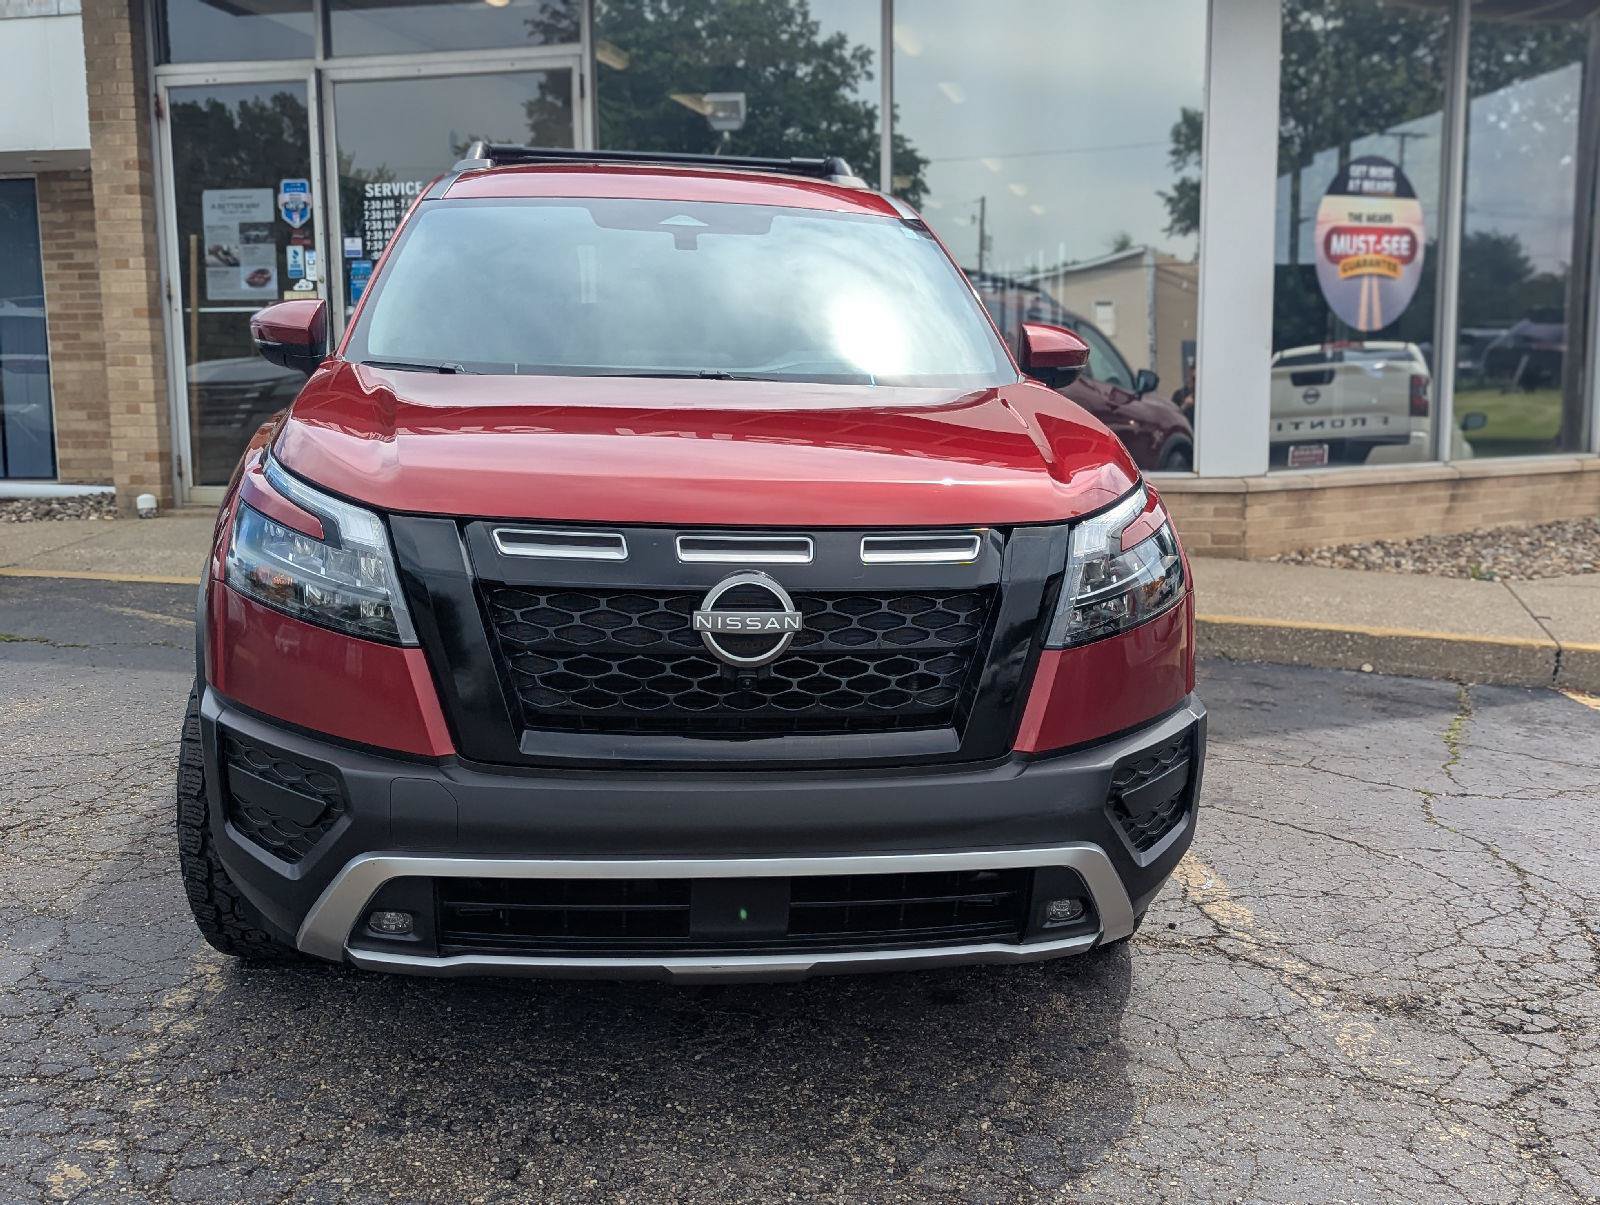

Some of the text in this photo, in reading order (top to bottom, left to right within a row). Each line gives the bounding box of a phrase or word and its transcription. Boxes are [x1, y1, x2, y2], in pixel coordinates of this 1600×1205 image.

[364, 181, 423, 198] SERVICE
[382, 199, 395, 209] AM
[383, 209, 396, 219] AM
[1330, 234, 1411, 256] MUST-SEE
[696, 615, 800, 630] NISSAN
